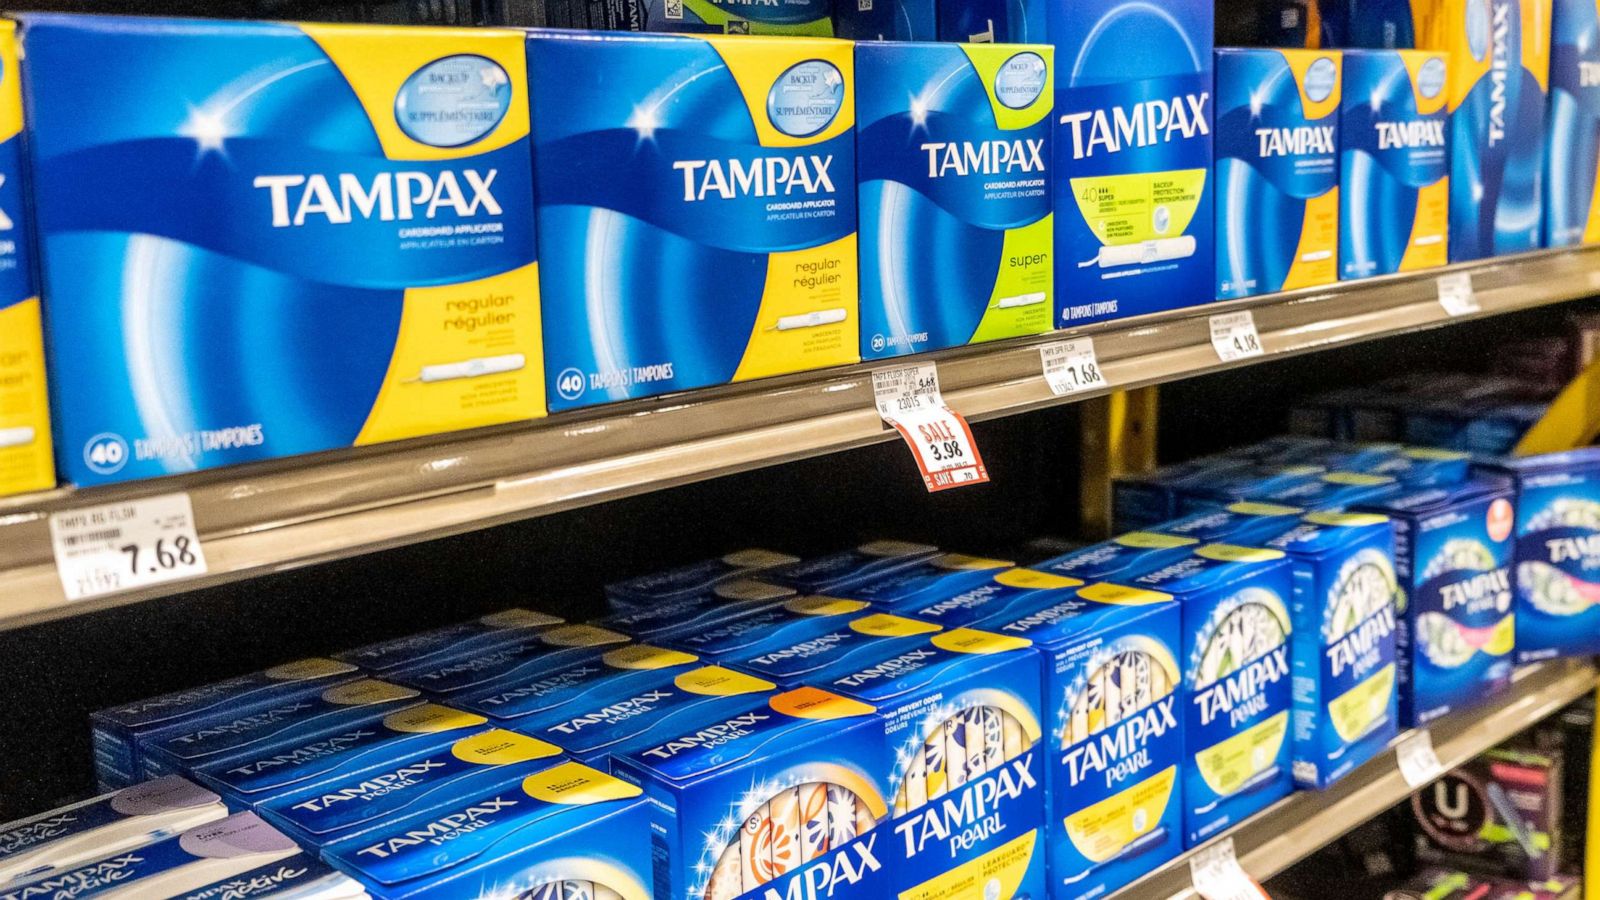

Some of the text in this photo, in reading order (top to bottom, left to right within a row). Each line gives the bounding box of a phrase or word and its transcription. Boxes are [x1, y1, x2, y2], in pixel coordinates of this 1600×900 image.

[790, 75, 817, 84] BACKUP
[1060, 92, 1209, 160] TAMPAX
[1374, 120, 1445, 150] TAMPAX
[1255, 126, 1335, 158] TAMPAX
[920, 138, 1045, 178] TAMPAX
[672, 155, 835, 201] TAMPAX
[984, 179, 1045, 190] CARDBOARD APPLICATOR
[254, 168, 503, 227] TAMPAX
[766, 199, 835, 212] CARDBOARD APPLICATOR
[1081, 187, 1098, 203] 40
[795, 259, 841, 274] regular
[1009, 253, 1047, 269] super
[793, 274, 841, 290] régulier
[446, 294, 515, 314] regular
[1062, 307, 1070, 320] 40
[1070, 304, 1092, 319] TAMPONS
[444, 312, 516, 332] régulier
[873, 338, 884, 347] 20
[1233, 334, 1259, 352] 4.18
[561, 375, 583, 392] 40
[590, 363, 673, 390] TAMPONS TAMPONES
[904, 366, 920, 376] SUPER
[1067, 362, 1101, 385] 7.68
[897, 396, 921, 410] 23015
[200, 424, 264, 451] TAMPONES
[918, 420, 956, 444] SALE
[90, 440, 123, 464] 40
[929, 440, 963, 460] 3.98
[934, 470, 955, 486] SAVE
[120, 535, 198, 575] 7.68
[918, 585, 1003, 616] TAMPAX
[1439, 567, 1511, 610] TAMPAX
[1002, 600, 1087, 632] TAMPAX
[749, 632, 852, 665] TAMPAX
[1326, 607, 1397, 678] TAMPAX
[833, 649, 937, 687] TAMPAX
[478, 666, 600, 706] TAMPAX
[1193, 645, 1290, 725] TAMPAX
[547, 690, 674, 735] TAMPAX
[897, 699, 922, 714] PREVENT
[922, 692, 943, 704] ODORS
[642, 712, 771, 759] TAMPAX
[884, 721, 908, 735] ODEURS
[1061, 695, 1178, 787] TAMPAX
[226, 729, 375, 775] TAMPAX
[292, 760, 447, 812] TAMPAX
[1435, 780, 1469, 819] U
[894, 753, 1038, 859] TAMPAX
[357, 796, 519, 858] TAMPAX
[221, 866, 308, 900] active
